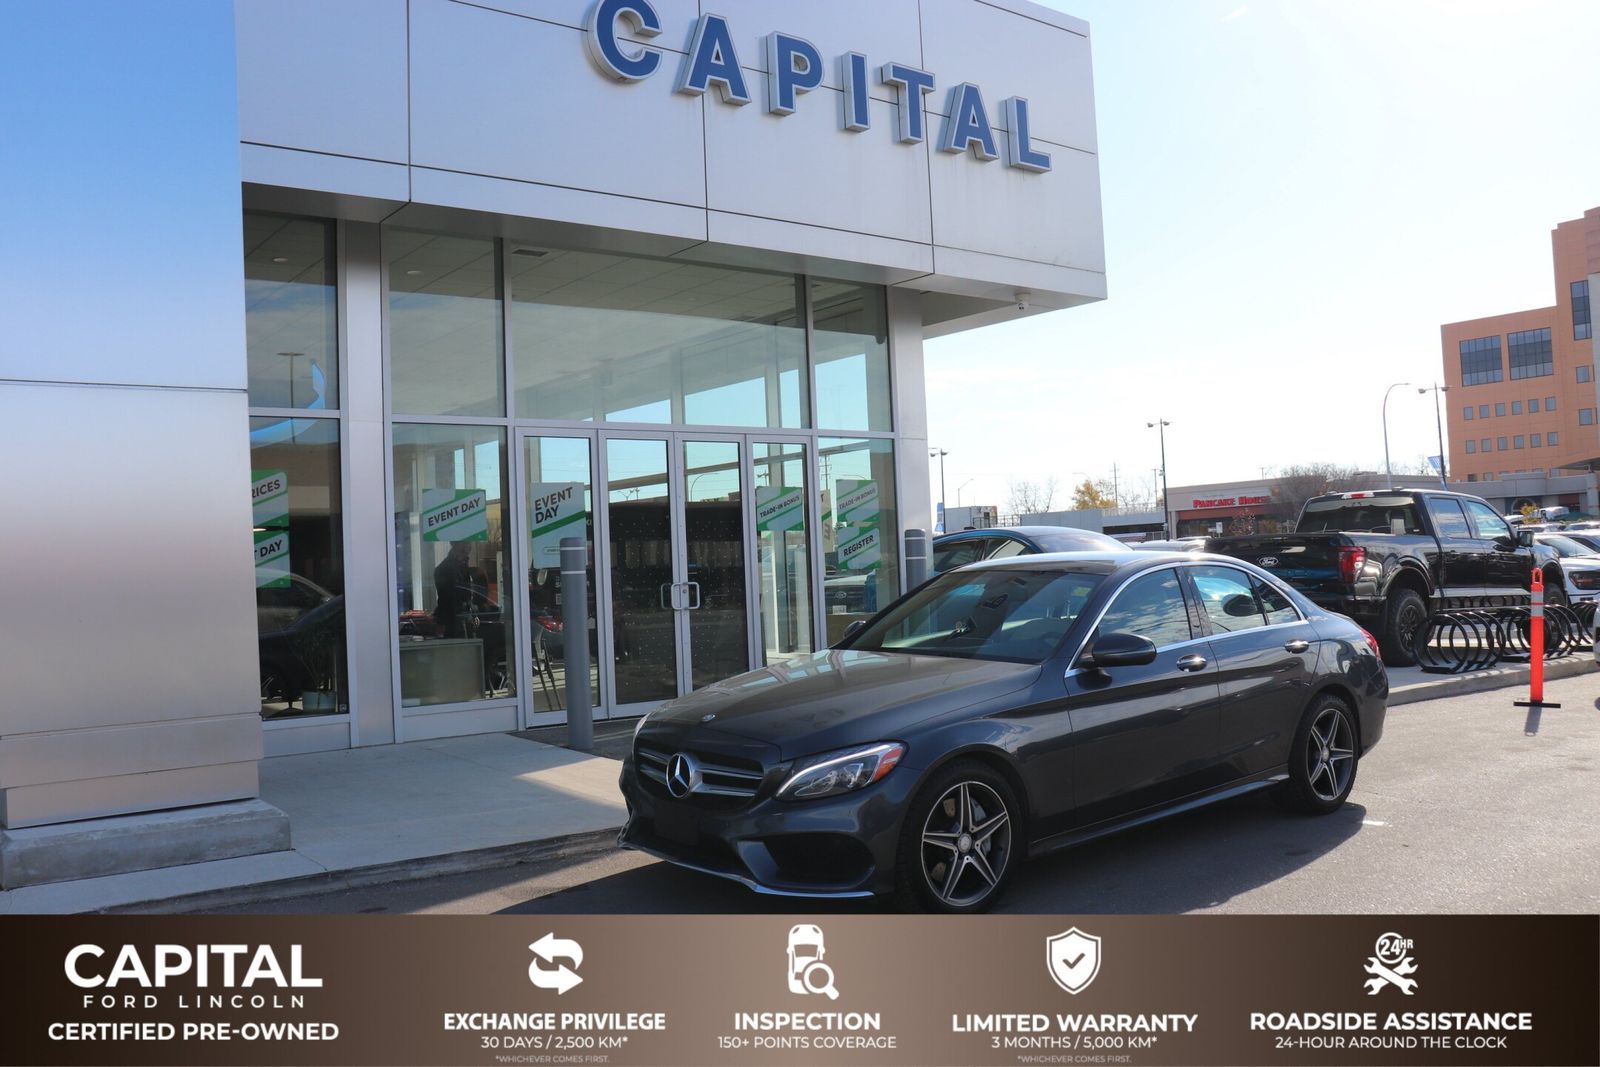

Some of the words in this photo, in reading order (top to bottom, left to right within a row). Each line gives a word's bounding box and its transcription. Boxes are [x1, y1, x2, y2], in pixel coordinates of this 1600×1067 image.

[588, 0, 1052, 173] CAPITAL
[535, 487, 573, 511] EVENT
[760, 501, 784, 518] TRADE-IN
[783, 495, 800, 508] BONUS
[428, 506, 459, 527] EVENT
[461, 497, 480, 513] DAY
[536, 505, 559, 524] DAY
[260, 540, 282, 557] DAY
[843, 535, 874, 556] REGISTER
